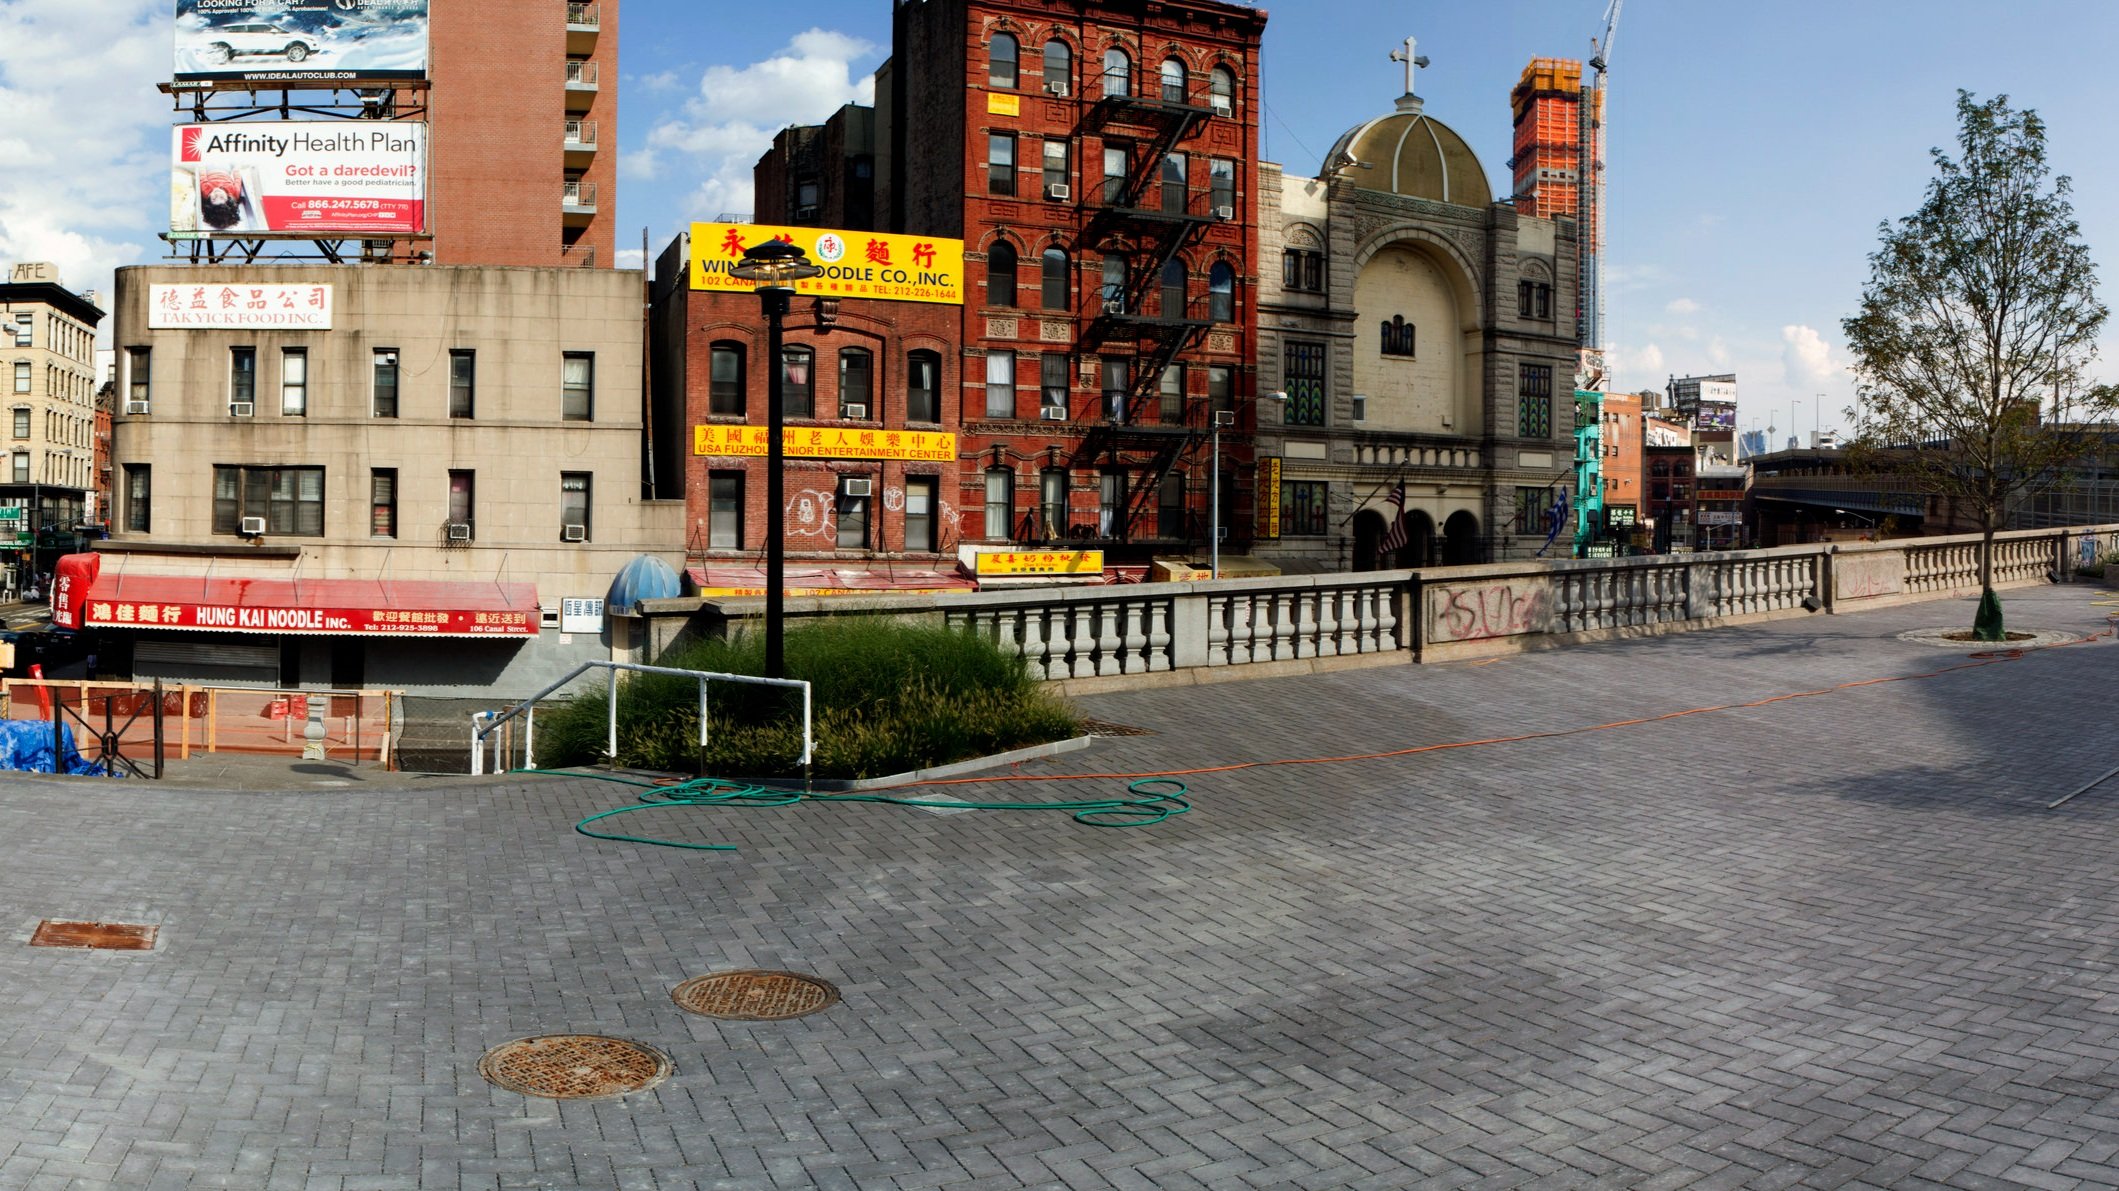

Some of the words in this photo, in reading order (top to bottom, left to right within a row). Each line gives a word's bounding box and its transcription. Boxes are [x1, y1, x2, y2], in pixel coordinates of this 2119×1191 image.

[244, 72, 356, 80] WWW.IDEALAUTOCLUB.COM
[207, 134, 288, 157] Affinity
[294, 132, 364, 151] Health
[371, 132, 416, 151] Plan
[285, 165, 314, 176] Got
[319, 167, 328, 176] a
[333, 165, 416, 177] daredevil?
[341, 179, 363, 187] good
[365, 179, 416, 187] pediatrician.
[308, 200, 379, 209] 866.247.5678
[702, 276, 720, 286] 102
[874, 285, 891, 295] TEL:
[894, 286, 956, 299] 212-226-1644
[160, 287, 325, 311] 德益食品公司
[160, 313, 191, 324] TAK
[195, 313, 234, 324] YICK
[238, 313, 285, 324] FOOD
[288, 313, 324, 324] INC.
[699, 444, 721, 453] USA
[817, 446, 906, 458] ENTERTAINMENT
[909, 449, 951, 460] CENTER
[93, 603, 181, 623] 鴻佳麵行
[196, 607, 236, 626] HUNG
[239, 609, 265, 627] KAI
[268, 610, 324, 629] NOODLE
[325, 617, 352, 629] INC.
[381, 624, 439, 632] 212-925-3898
